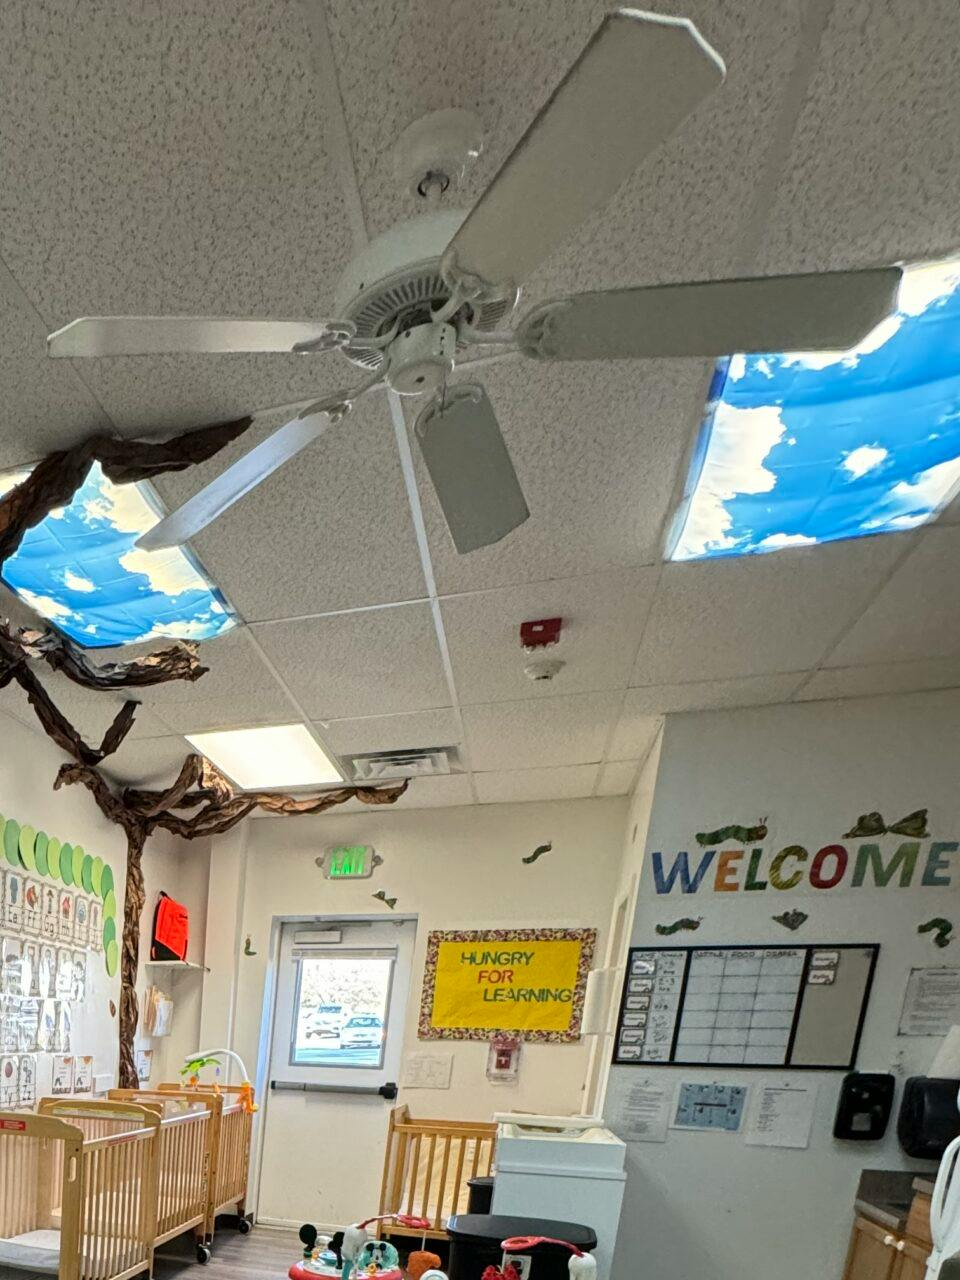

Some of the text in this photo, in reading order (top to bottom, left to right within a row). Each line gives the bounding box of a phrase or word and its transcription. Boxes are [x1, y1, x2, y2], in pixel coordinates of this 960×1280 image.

[330, 846, 366, 876] EXIT
[651, 842, 960, 895] WELCOME
[460, 951, 535, 966] HUNGRY
[477, 969, 514, 984] FOR
[482, 988, 573, 1003] LEARNING
